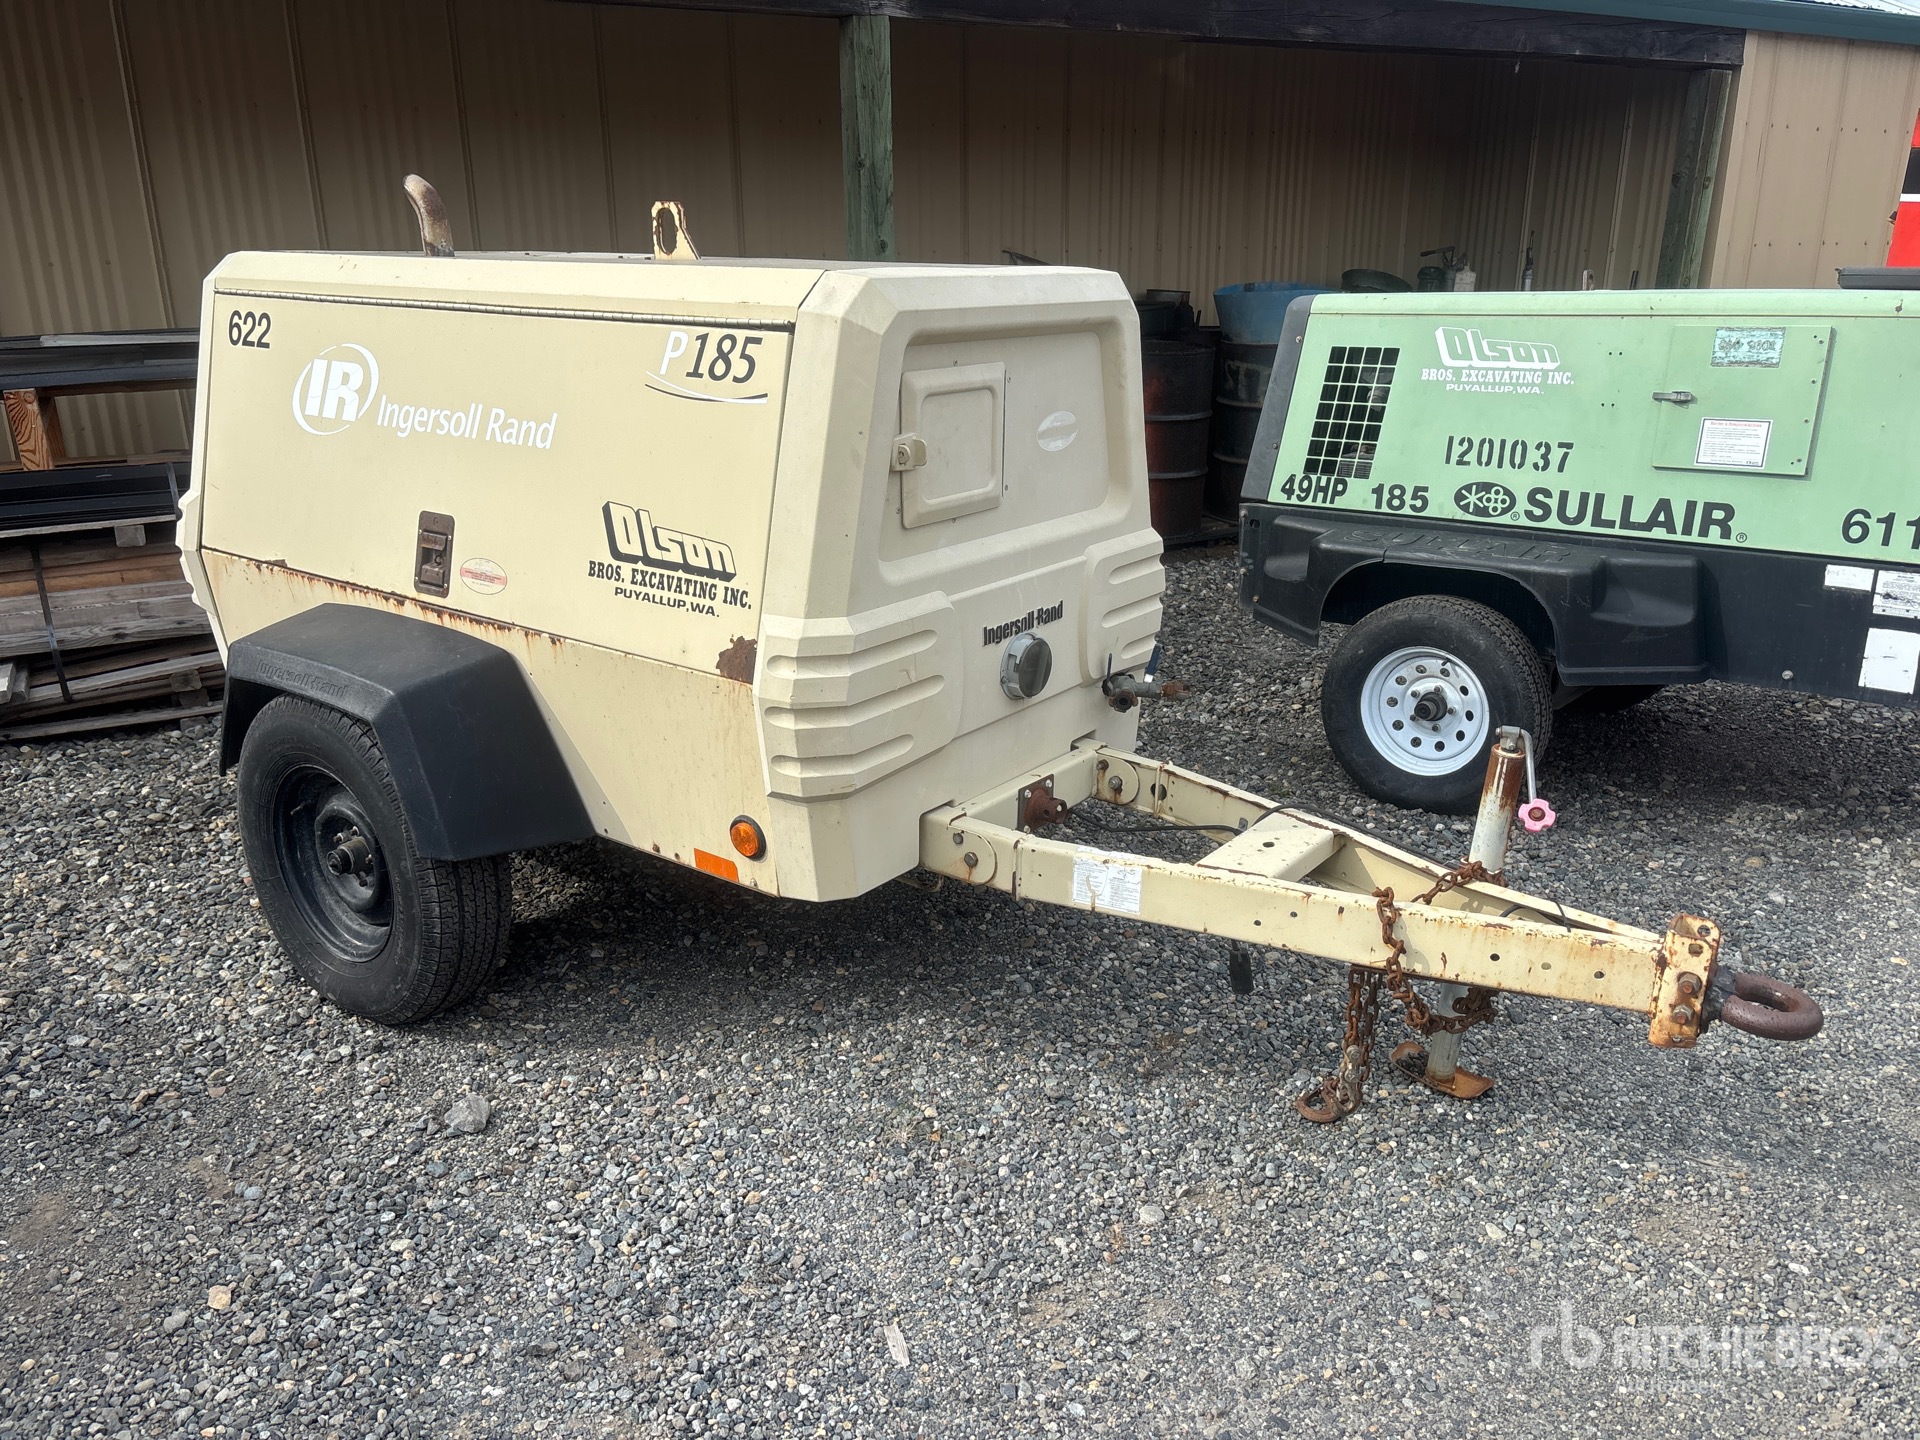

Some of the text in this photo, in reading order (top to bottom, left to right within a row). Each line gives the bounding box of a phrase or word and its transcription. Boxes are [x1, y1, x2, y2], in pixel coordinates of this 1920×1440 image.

[228, 310, 272, 349] 622
[304, 358, 364, 422] IR
[1421, 368, 1575, 385] BROS. EXCAVATING INC.
[377, 394, 558, 450] Ingersoll Rand
[1445, 435, 1574, 473] 1201037
[1281, 474, 1429, 513] 49HP 185
[1524, 486, 1736, 540] SULLAIR
[588, 560, 752, 610] BROS. EXCAVATING INC.
